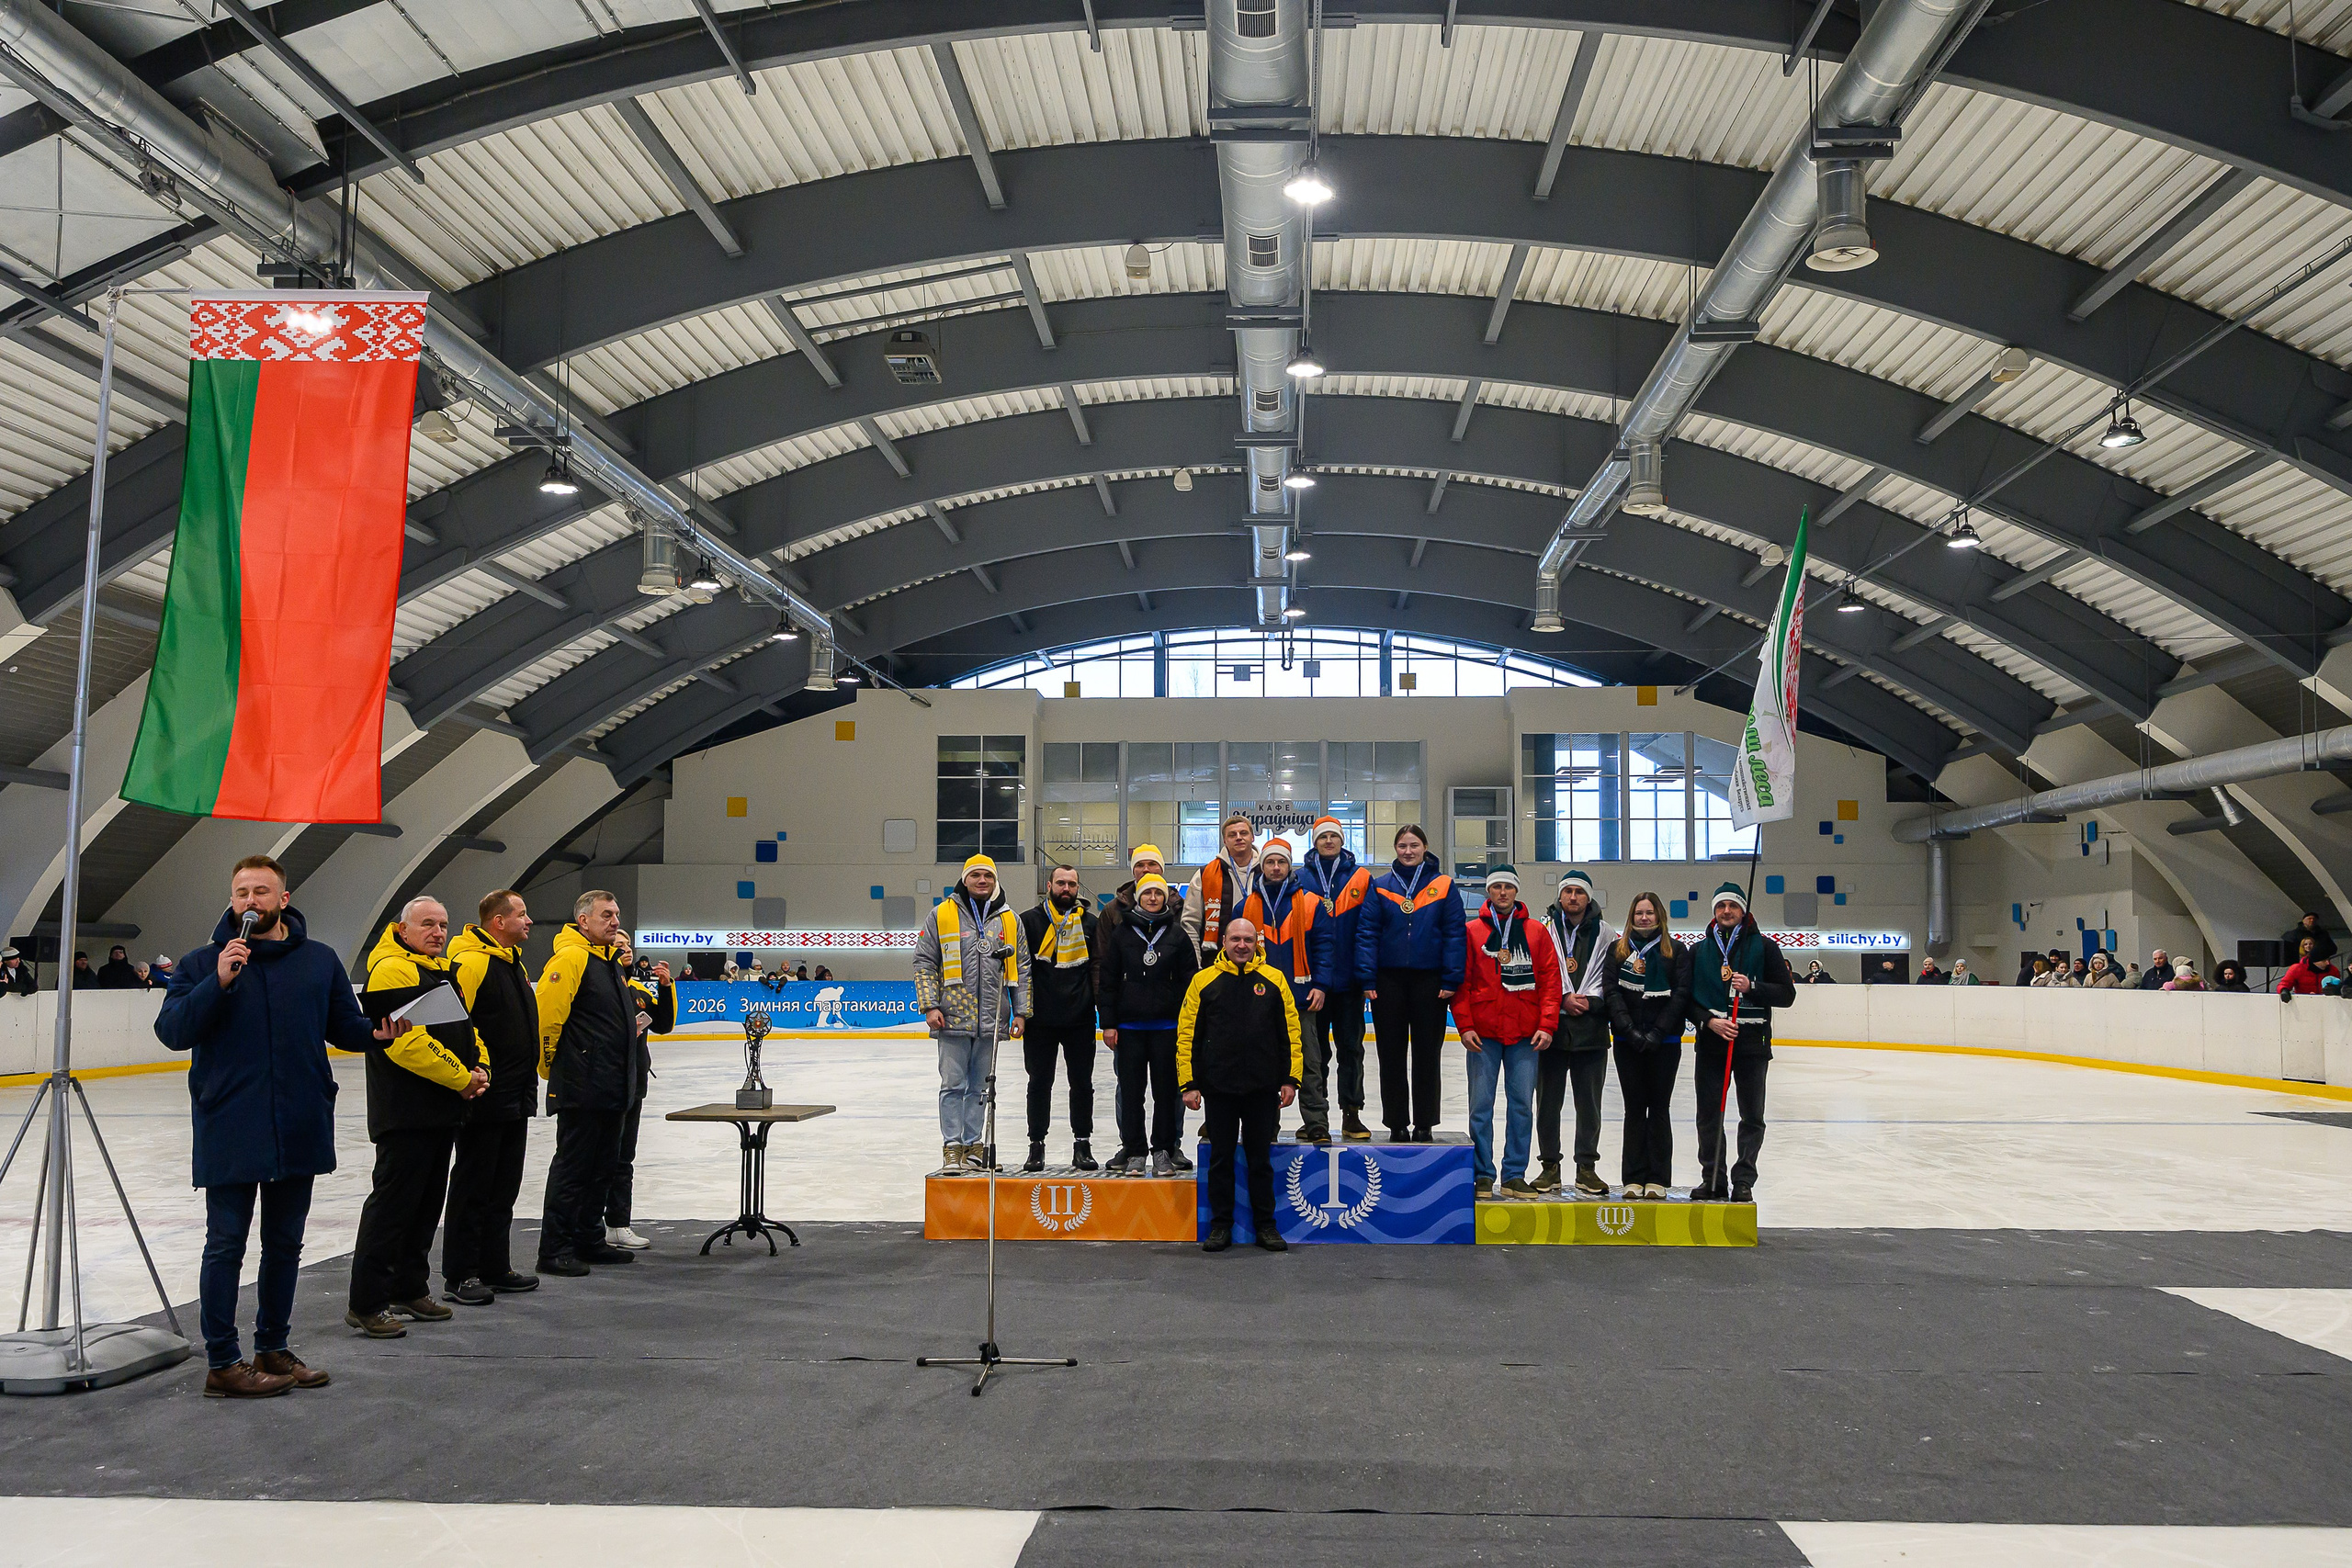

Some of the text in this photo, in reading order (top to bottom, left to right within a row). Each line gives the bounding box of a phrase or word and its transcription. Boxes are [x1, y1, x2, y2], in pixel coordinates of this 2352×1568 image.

[1747, 754, 1774, 808] леса
[642, 931, 714, 946] silichy.by
[1827, 933, 1903, 947] silichy.by
[687, 998, 726, 1013] 2026
[740, 998, 800, 1013] Зимняя
[804, 998, 905, 1015] спартакиада
[1046, 1185, 1076, 1215] II
[1603, 1207, 1629, 1224] III
